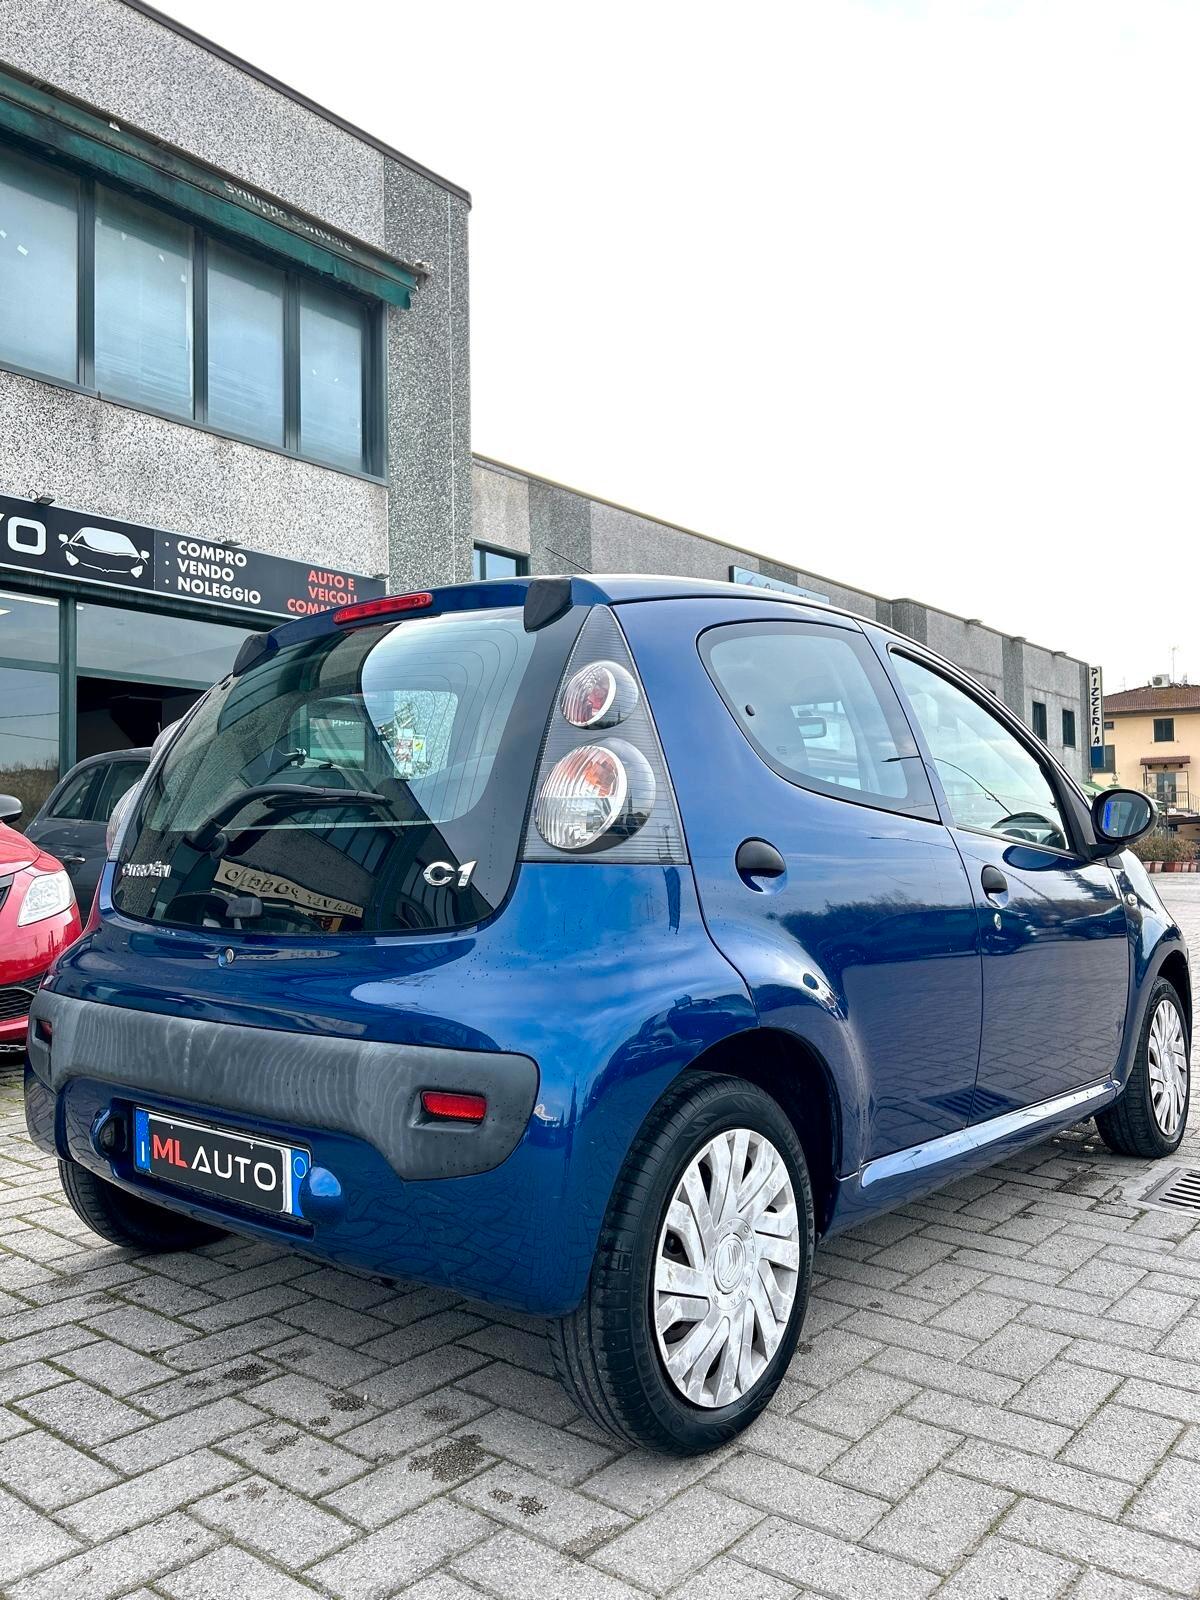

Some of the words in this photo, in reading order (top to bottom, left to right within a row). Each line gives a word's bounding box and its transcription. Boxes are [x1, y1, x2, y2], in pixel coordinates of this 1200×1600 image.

[0, 513, 47, 556] O
[177, 540, 248, 568] COMPRO
[177, 558, 235, 582] VENDO
[308, 570, 345, 589] AUTO
[348, 578, 355, 591] E
[177, 579, 261, 605] NOLEGGIO
[1091, 668, 1100, 745] PIZZERIA
[122, 861, 171, 878] CITROËN
[423, 861, 477, 887] C1
[152, 1134, 188, 1168] ML
[191, 1146, 276, 1191] AUTO
